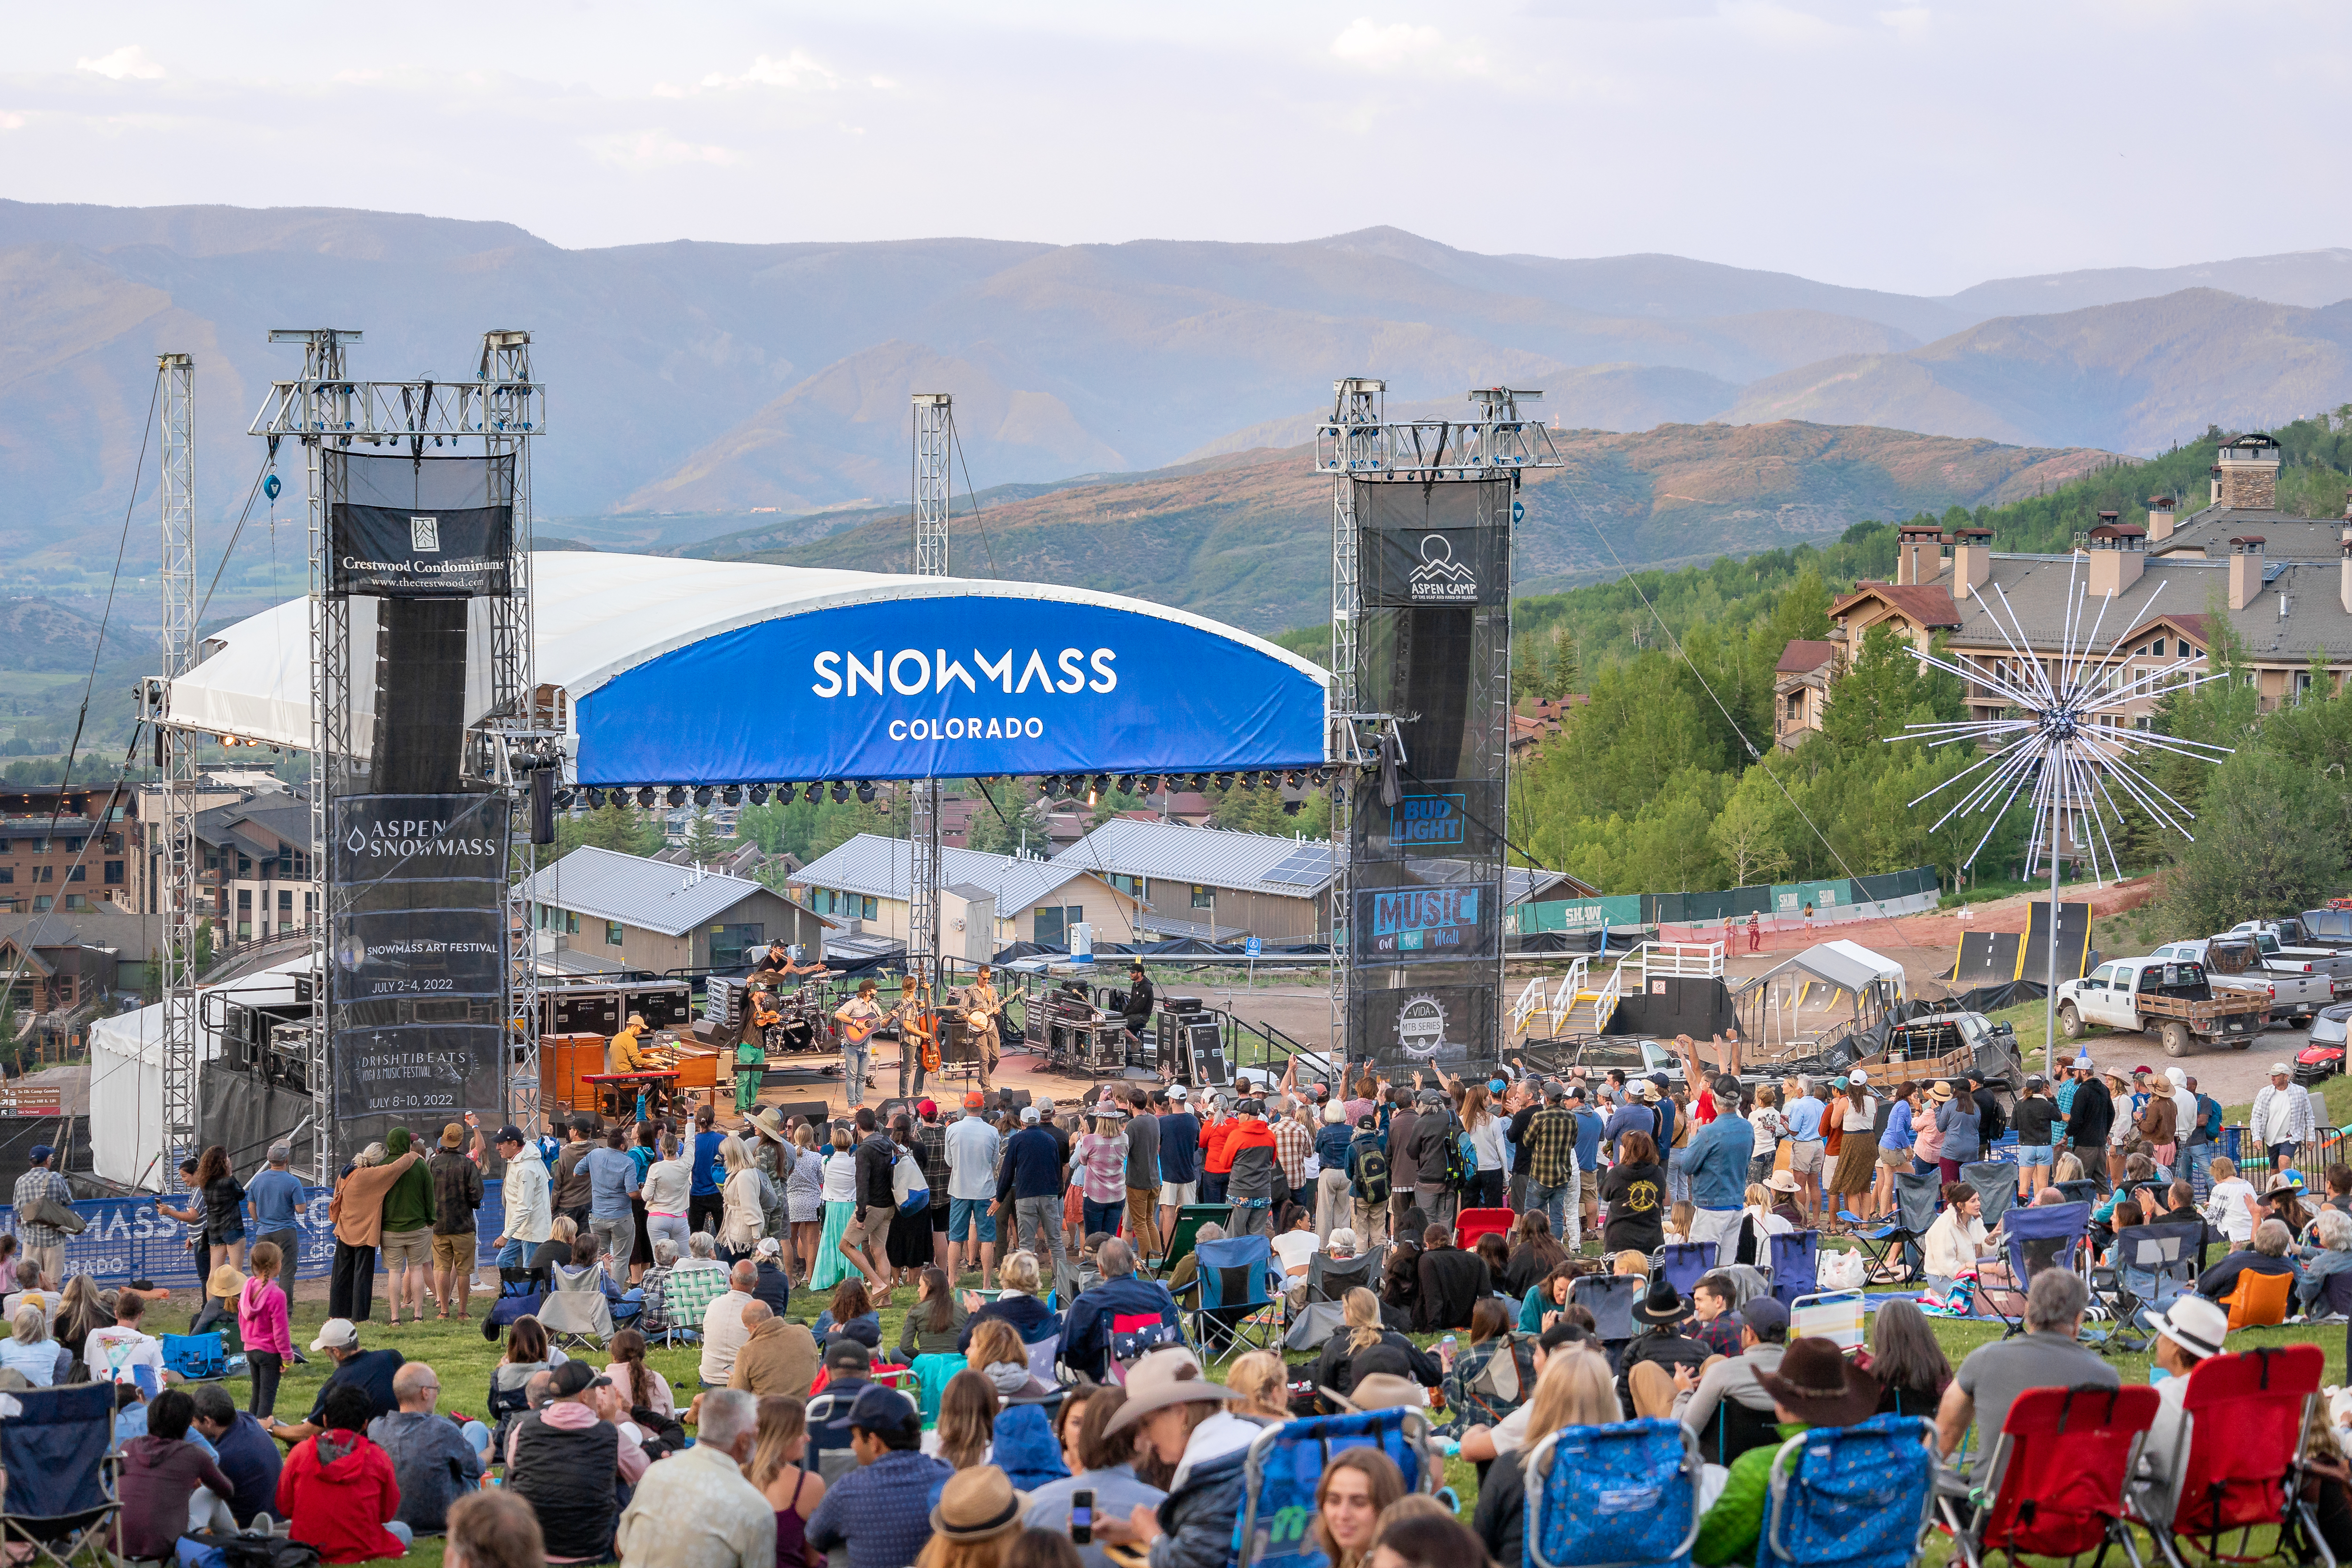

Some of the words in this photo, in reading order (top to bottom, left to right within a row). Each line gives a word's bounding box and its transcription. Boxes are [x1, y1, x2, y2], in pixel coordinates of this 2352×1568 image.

[343, 557, 412, 573] Crestwood
[414, 560, 504, 573] Condominiums
[371, 577, 484, 588] www.thecrestwood.com
[1412, 583, 1444, 594] ASPEN
[1446, 584, 1476, 594] CAMP
[811, 648, 1117, 698] SNOWMASS
[889, 717, 1043, 741] COLORADO
[1404, 800, 1451, 820] BUD
[371, 820, 445, 837] ASPEN
[1393, 819, 1459, 840] LIGHT
[371, 839, 495, 857] SNOWMASS
[1779, 893, 1798, 907] SHAW
[1379, 887, 1471, 931] MUSIC
[1565, 906, 1601, 923] SHAW
[1379, 938, 1392, 950] on
[1404, 935, 1418, 947] the
[1434, 929, 1460, 946] Mall
[367, 943, 423, 956] SNOWMASS
[425, 943, 448, 952] ART
[450, 943, 498, 953] FESTIVAL
[372, 982, 396, 993] JULY
[424, 979, 453, 990] 2022
[1413, 1006, 1430, 1017] VIDA
[1418, 1021, 1441, 1031] SERIES
[362, 1052, 466, 1067] DRISHTIBEATS
[363, 1070, 375, 1082] YOGA
[377, 1069, 381, 1079] &
[383, 1067, 401, 1079] MUSIC
[404, 1066, 432, 1078] FESTIVAL
[369, 1098, 389, 1108] JULY
[424, 1095, 453, 1106] 2022
[96, 1337, 143, 1347] Timberland
